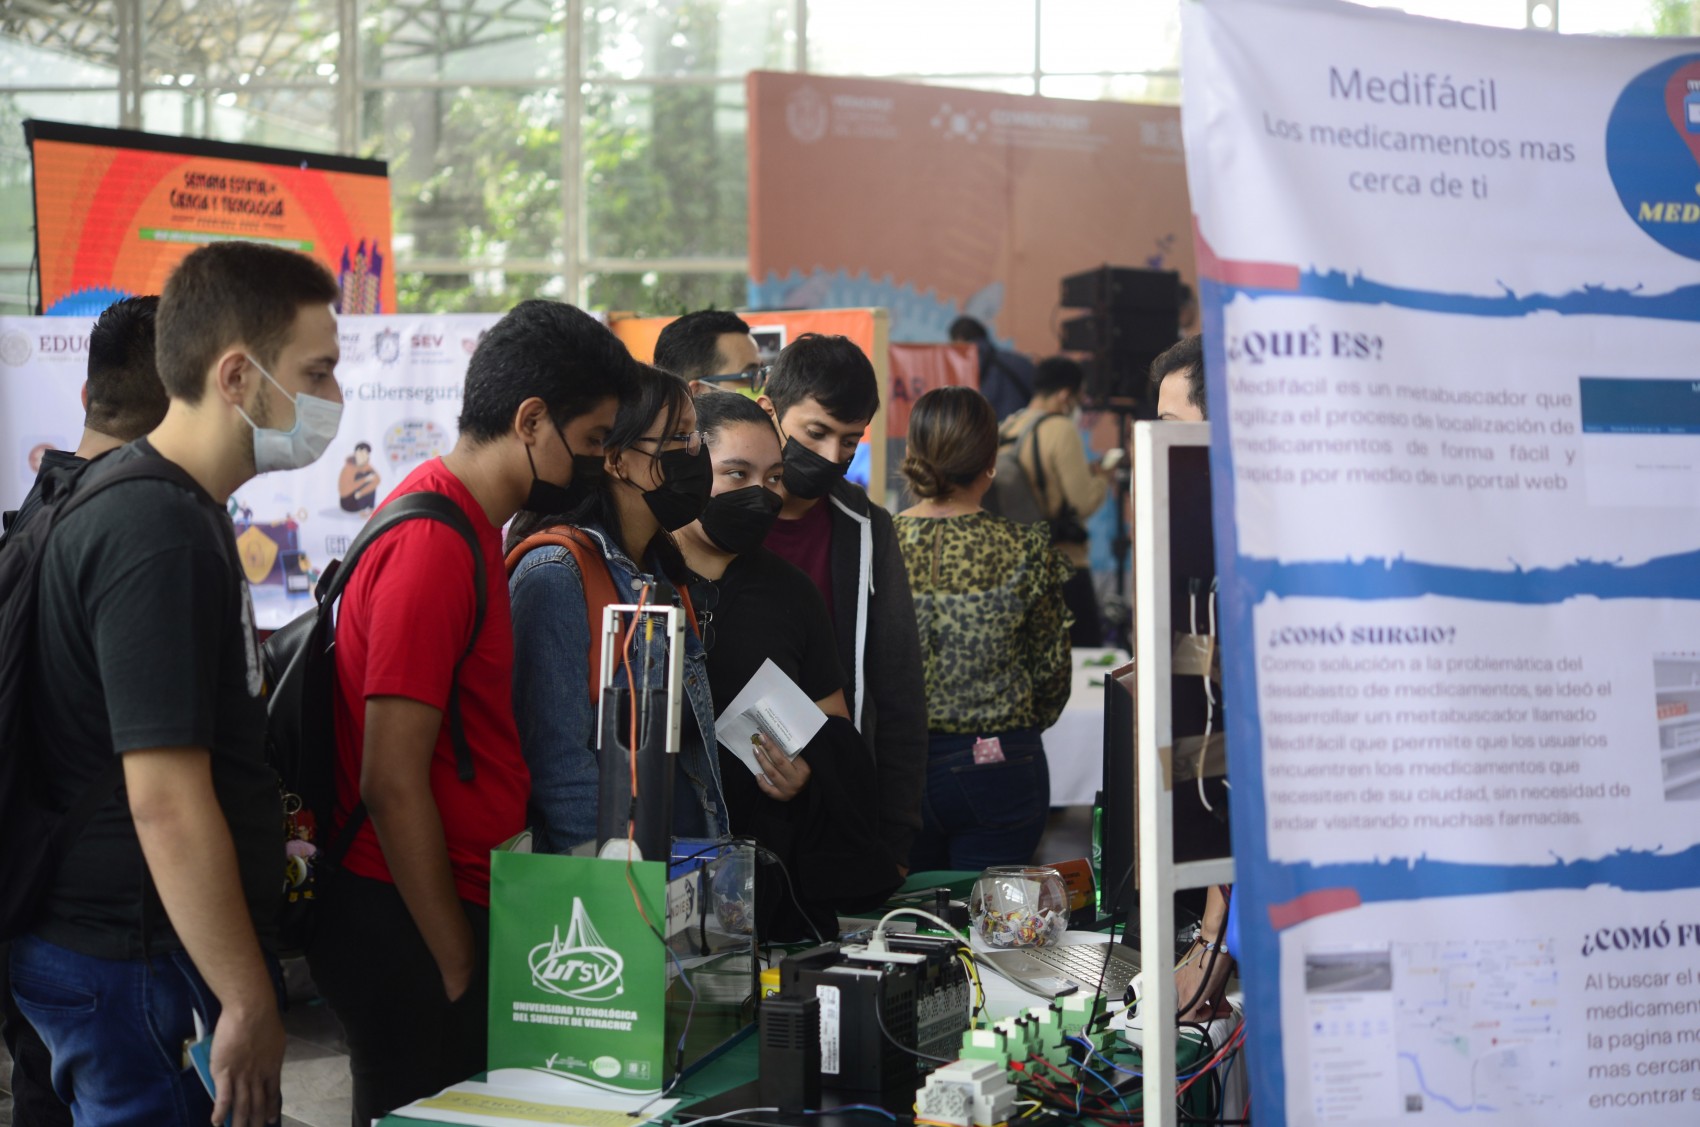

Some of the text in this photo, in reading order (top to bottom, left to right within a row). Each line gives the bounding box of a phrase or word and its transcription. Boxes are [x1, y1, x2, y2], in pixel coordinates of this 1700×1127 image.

[1328, 66, 1498, 111] Medifácil
[1262, 112, 1576, 162] Los medicamentos mas
[1348, 169, 1488, 199] cerca de ti
[1228, 325, 1384, 363] ¿QUÉ ES?
[1336, 381, 1361, 397] es
[1367, 380, 1392, 397] un
[1536, 392, 1572, 411] que
[1326, 410, 1410, 430] proceso
[1550, 418, 1574, 435] de
[1406, 439, 1428, 456] de
[1441, 441, 1495, 460] forma
[1564, 449, 1576, 465] y
[1346, 465, 1413, 484] medio
[1416, 467, 1438, 485] de
[1442, 473, 1463, 487] un
[1467, 472, 1520, 491] portal
[1525, 473, 1567, 490] web
[1351, 625, 1457, 646] SURGIO?
[1556, 655, 1582, 672] del
[1363, 680, 1389, 698] de
[1365, 709, 1391, 725] un
[1393, 734, 1472, 753] permite
[1476, 735, 1508, 752] que
[1512, 732, 1536, 748] los
[1539, 732, 1607, 748] usuarios
[1409, 757, 1546, 776] medicamentos
[1549, 759, 1580, 777] que
[1521, 783, 1606, 800] necesidad
[1610, 782, 1631, 798] de
[1414, 810, 1494, 828] muchas
[1585, 968, 1692, 991] Al buscar el
[512, 1001, 574, 1016] UNIVERSIDAD
[512, 1012, 632, 1031] DEL SURESTE DE VERACRUZ
[1587, 1031, 1603, 1049] la
[1608, 1028, 1672, 1052] pagina
[1588, 1062, 1631, 1080] mas
[1589, 1087, 1687, 1110] encontrar
